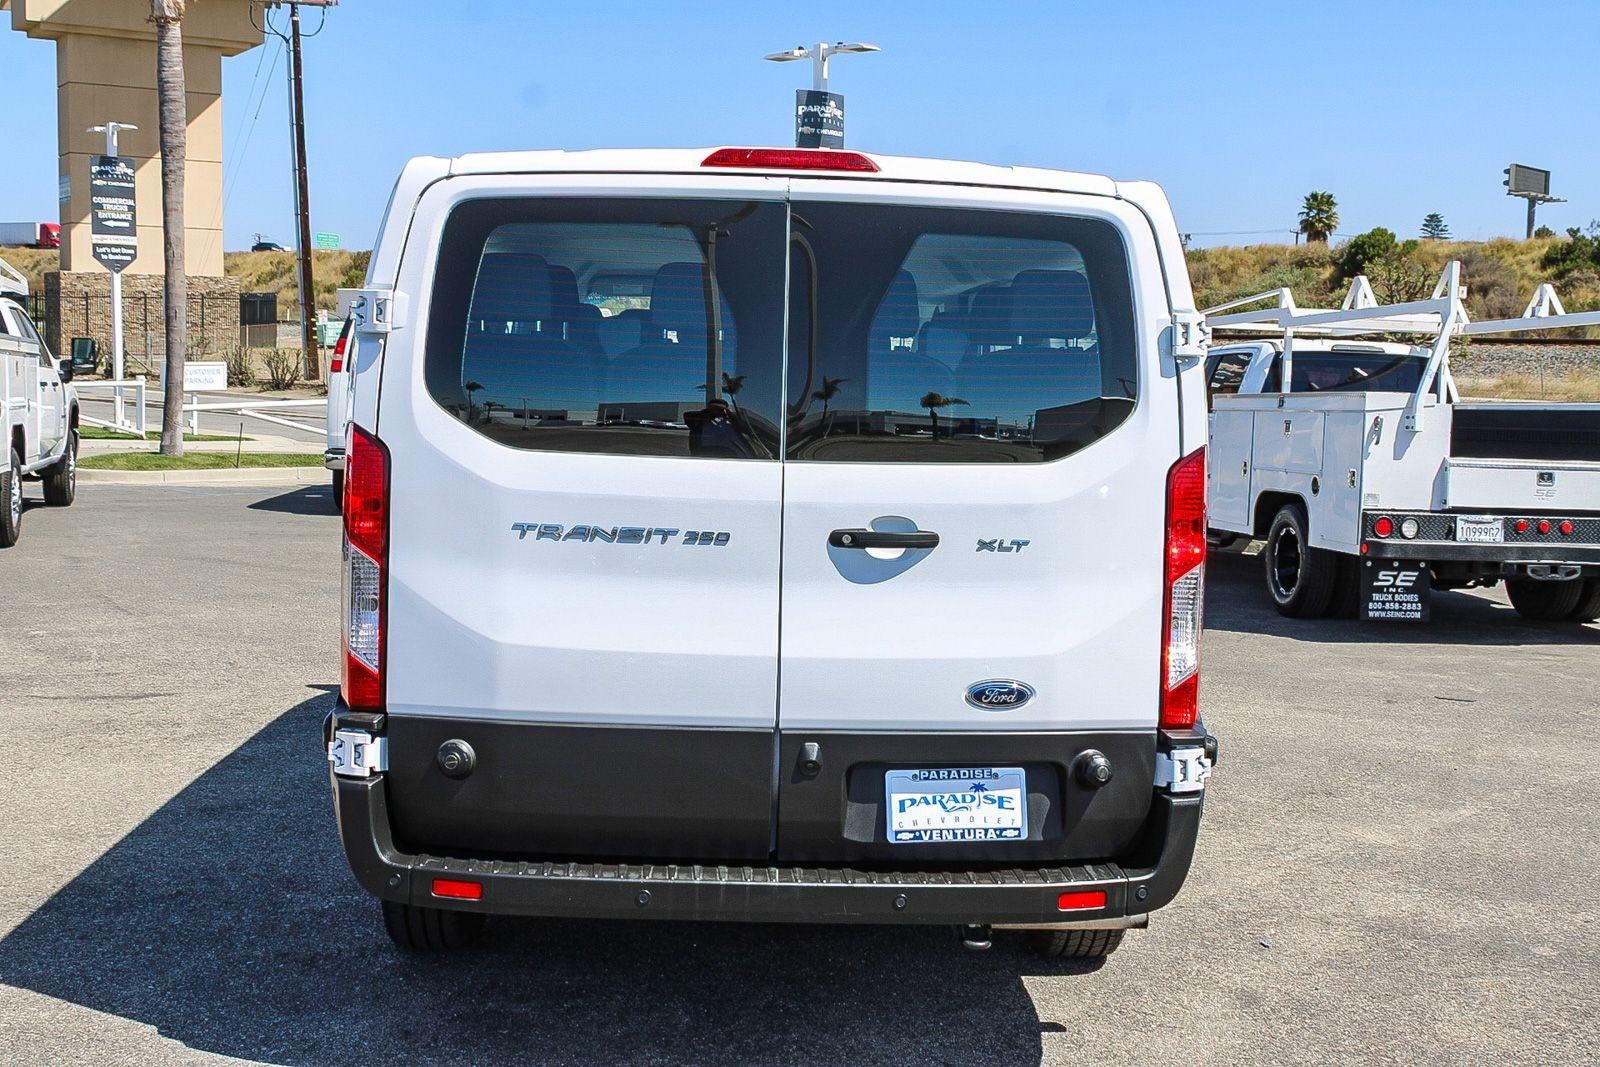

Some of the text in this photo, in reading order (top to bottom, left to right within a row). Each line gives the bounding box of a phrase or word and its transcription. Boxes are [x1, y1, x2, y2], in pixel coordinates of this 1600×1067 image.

[92, 196, 135, 206] COMMERCIAL
[102, 203, 129, 211] TRUCKS
[97, 212, 133, 220] ENTRANCE
[511, 522, 731, 547] TRANSIT 350
[975, 538, 1031, 553] XLT
[1373, 571, 1420, 586] SE
[1372, 593, 1419, 602] TRUCK BODIES
[1368, 602, 1422, 610] 800-858-2883
[1367, 610, 1421, 619] WWW.SEINC.COM
[981, 686, 1018, 704] Ford
[920, 769, 992, 781] PARADISE
[898, 787, 1015, 813] PARADISE
[898, 816, 1016, 829] CHEVROLET
[921, 828, 998, 841] VENTURA
